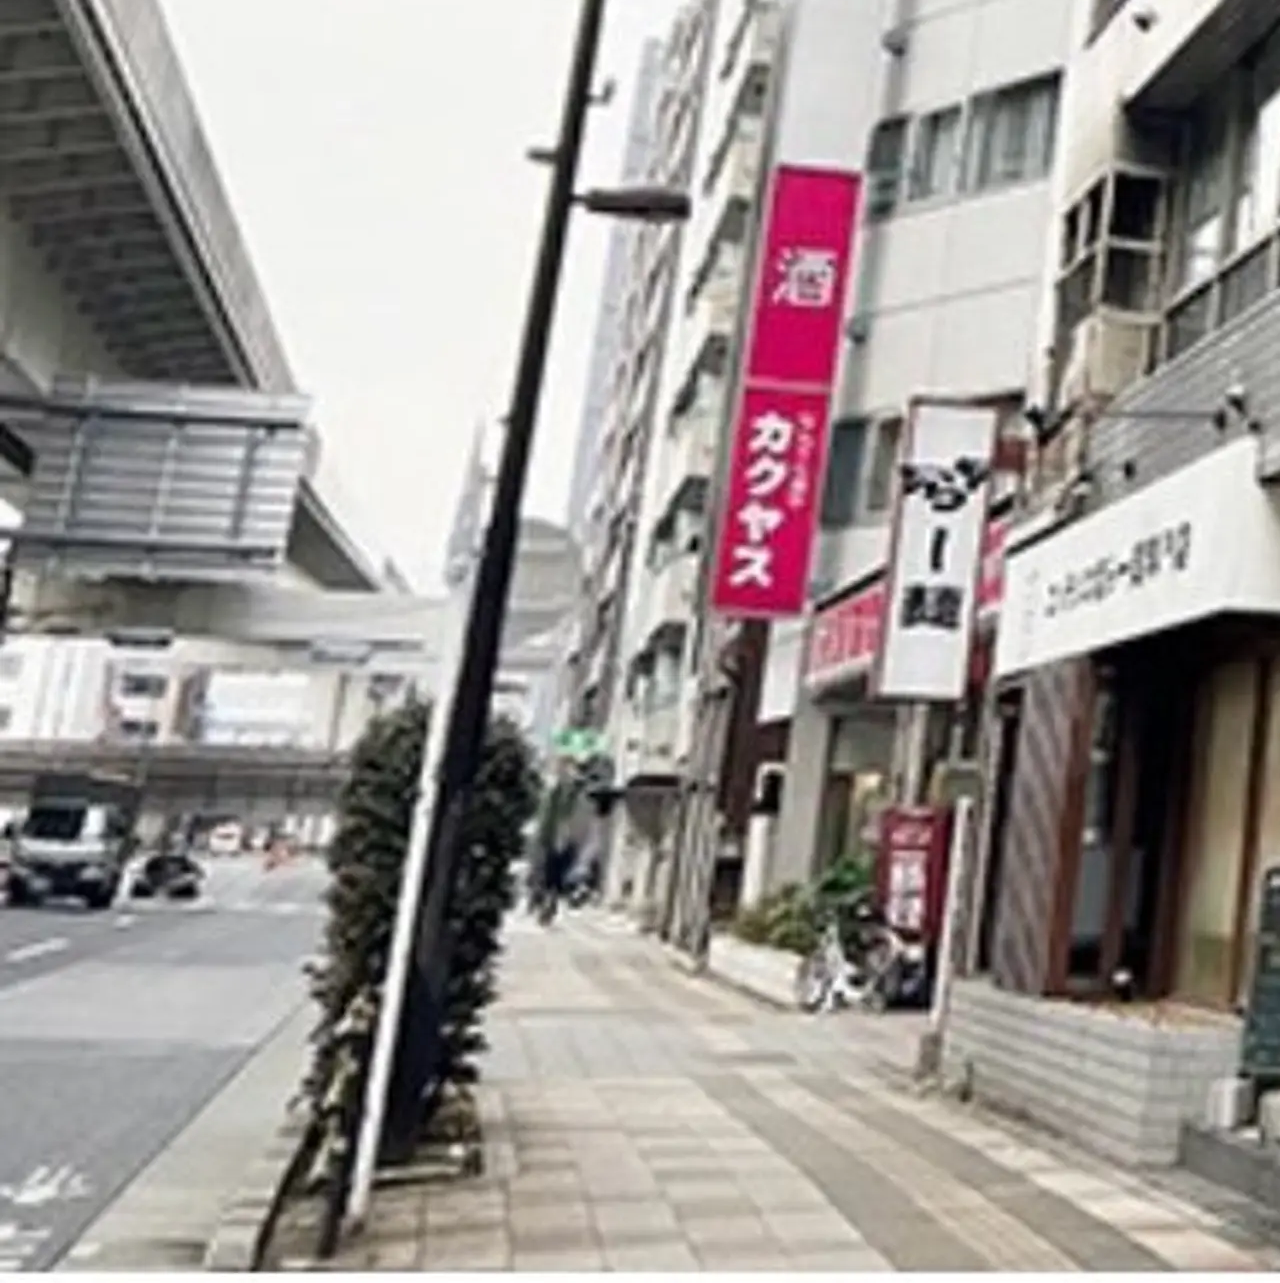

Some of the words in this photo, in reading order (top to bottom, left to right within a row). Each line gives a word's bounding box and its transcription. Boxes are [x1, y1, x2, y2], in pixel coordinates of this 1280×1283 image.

[772, 245, 839, 308] 酒
[728, 410, 793, 588] カクヤス
